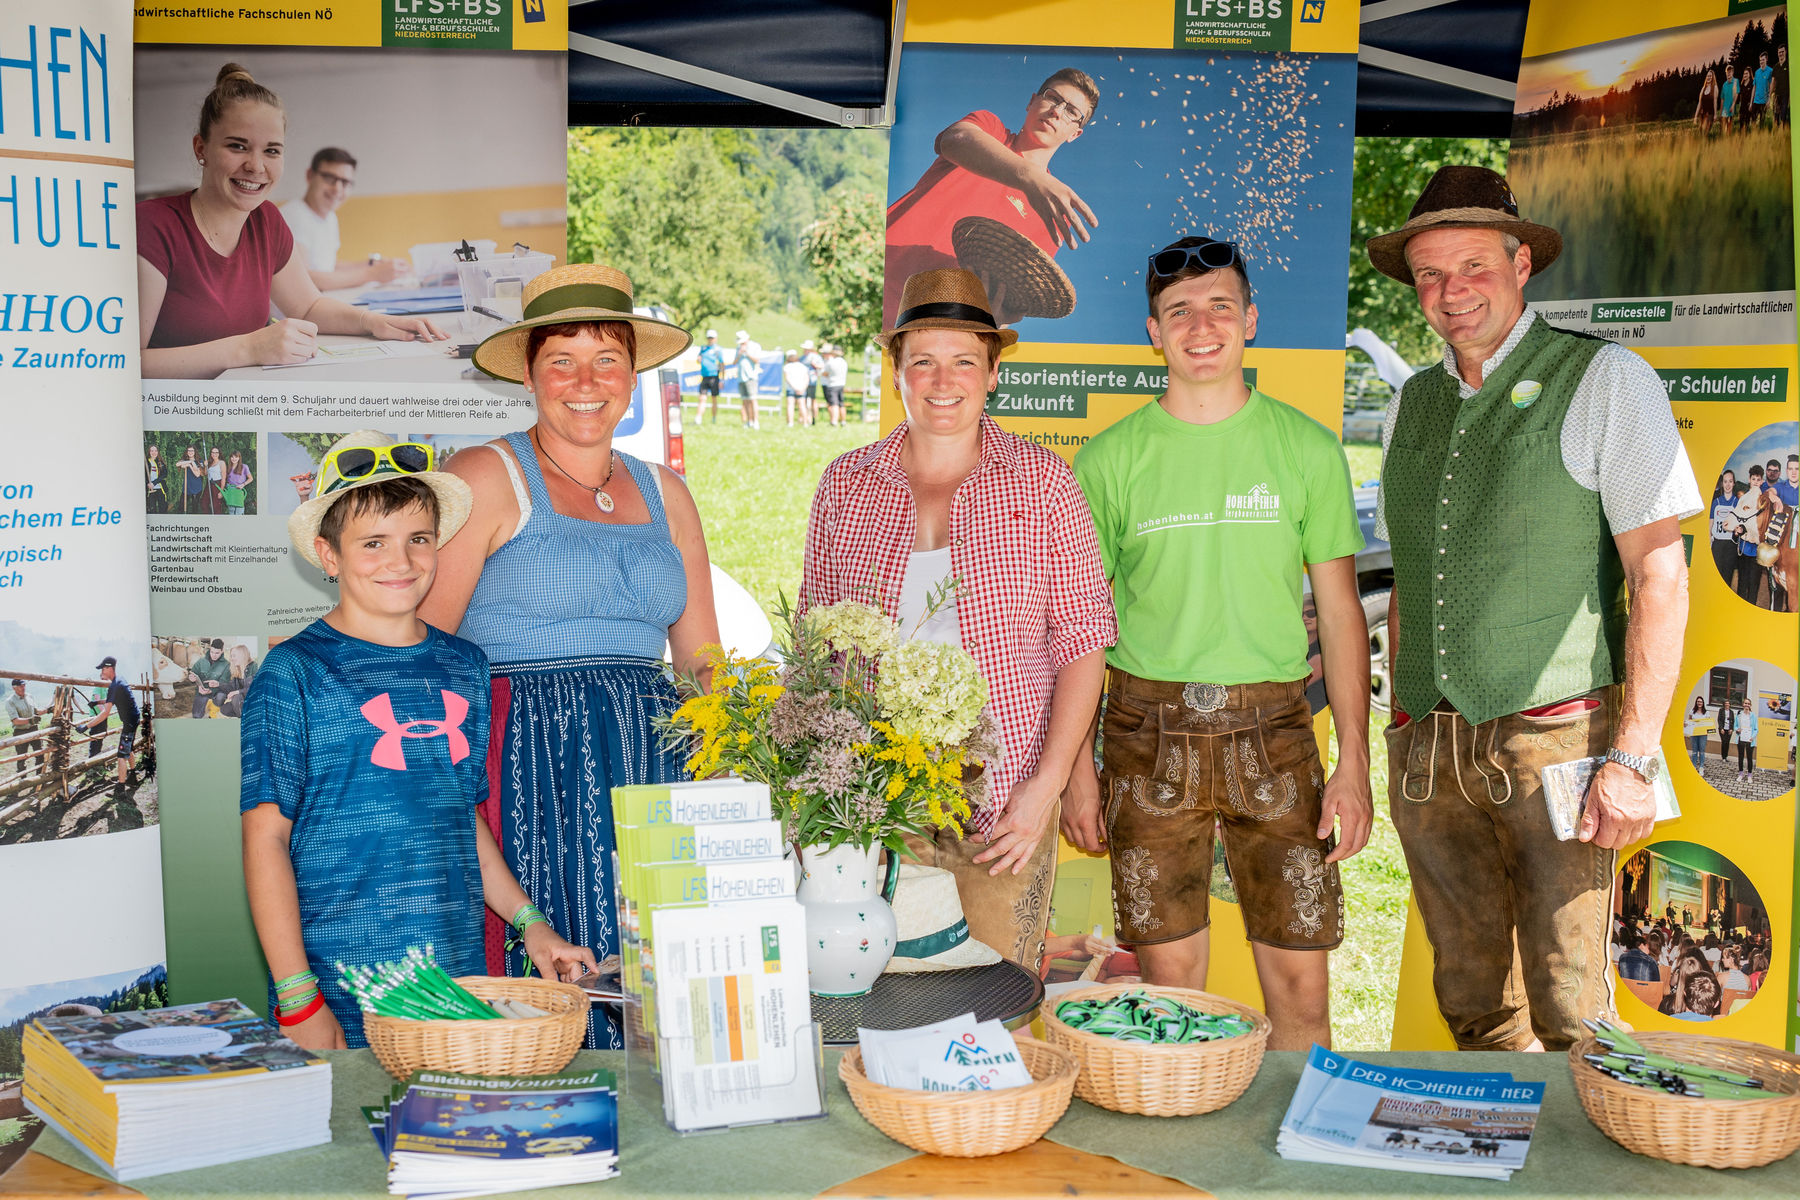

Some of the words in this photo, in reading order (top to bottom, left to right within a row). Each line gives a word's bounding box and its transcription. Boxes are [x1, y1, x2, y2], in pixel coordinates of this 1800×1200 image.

[239, 8, 311, 20] Fachschulen
[315, 8, 333, 20] NÖ
[395, 17, 494, 26] LANDWIRTSCHAFTLICHE
[1185, 21, 1267, 29] LANDWIRTSCHAFTLICHE
[395, 31, 477, 39] NIEDERÖSTERREICH
[430, 25, 500, 33] BERUFSSCHULEN
[1545, 309, 1588, 321] kompetente
[1597, 305, 1666, 319] Servicestelle
[1674, 304, 1687, 316] für
[1688, 303, 1700, 315] die
[1702, 301, 1793, 315] Landwirtschaftlichen
[1621, 327, 1630, 338] in
[1632, 324, 1645, 338] NÖ
[12, 347, 125, 369] Zaunform
[1680, 375, 1746, 394] Schulen
[1751, 375, 1776, 394] bei
[147, 393, 200, 404] Ausbildung
[202, 394, 238, 405] beginnt
[240, 394, 256, 403] mit
[257, 395, 278, 403] dem
[292, 395, 336, 405] Schuljahr
[359, 397, 389, 405] dauert
[391, 397, 440, 406] wahlweise
[442, 397, 460, 406] drei
[462, 398, 484, 407] oder
[485, 399, 502, 407] vier
[504, 398, 534, 408] Jahre.
[997, 393, 1075, 411] Zukunft
[154, 406, 170, 415] Die
[171, 406, 225, 417] Ausbildung
[227, 406, 264, 416] schließt
[266, 407, 280, 416] mit
[283, 408, 304, 417] dem
[306, 408, 386, 418] Facharbeiterbrief
[388, 409, 406, 418] und
[408, 409, 424, 418] der
[426, 409, 466, 419] Mittleren
[469, 410, 493, 419] Reife
[495, 410, 510, 420] ab.
[71, 506, 122, 526] Erbe
[1136, 511, 1214, 530] hohenlehen.at
[151, 535, 213, 543] Landwirtschaft
[151, 545, 213, 553] Landwirtschaft
[228, 546, 288, 555] Kleintierhaltung
[151, 555, 213, 563] Landwirtschaft
[151, 565, 194, 573] Gartenbau
[151, 575, 219, 583] Pferdewirtschaft
[151, 585, 187, 593] Weinbau
[207, 585, 243, 593] Obstbau
[267, 606, 304, 616] Zahlreiche
[305, 604, 331, 613] weitere
[648, 800, 672, 824] LFS
[672, 836, 696, 860] LFS
[683, 877, 707, 901] LFS
[1351, 1067, 1387, 1084] DER
